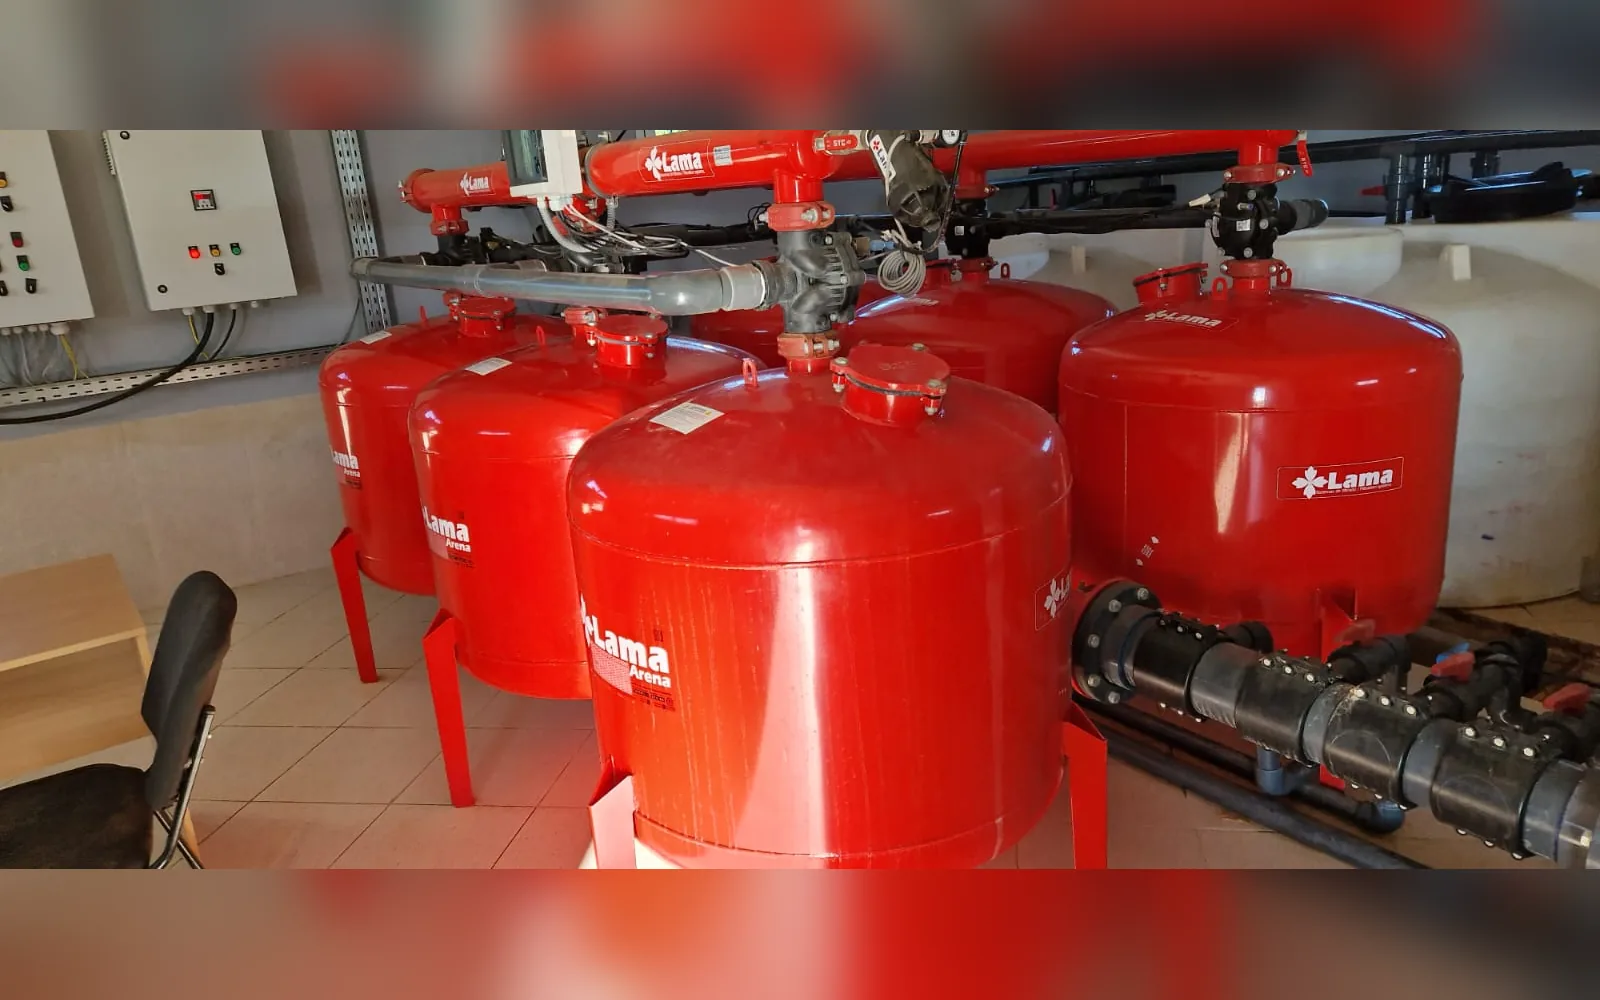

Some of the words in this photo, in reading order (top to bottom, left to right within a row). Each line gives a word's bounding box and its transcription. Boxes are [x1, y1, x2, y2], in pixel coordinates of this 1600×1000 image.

[662, 152, 704, 172] Lama
[469, 176, 489, 190] Lama
[1165, 312, 1222, 327] Lama
[1327, 469, 1393, 490] Lama
[423, 505, 470, 543] Lama
[446, 538, 471, 553] Arena
[592, 615, 669, 674] Lama
[629, 664, 671, 689] Arena
